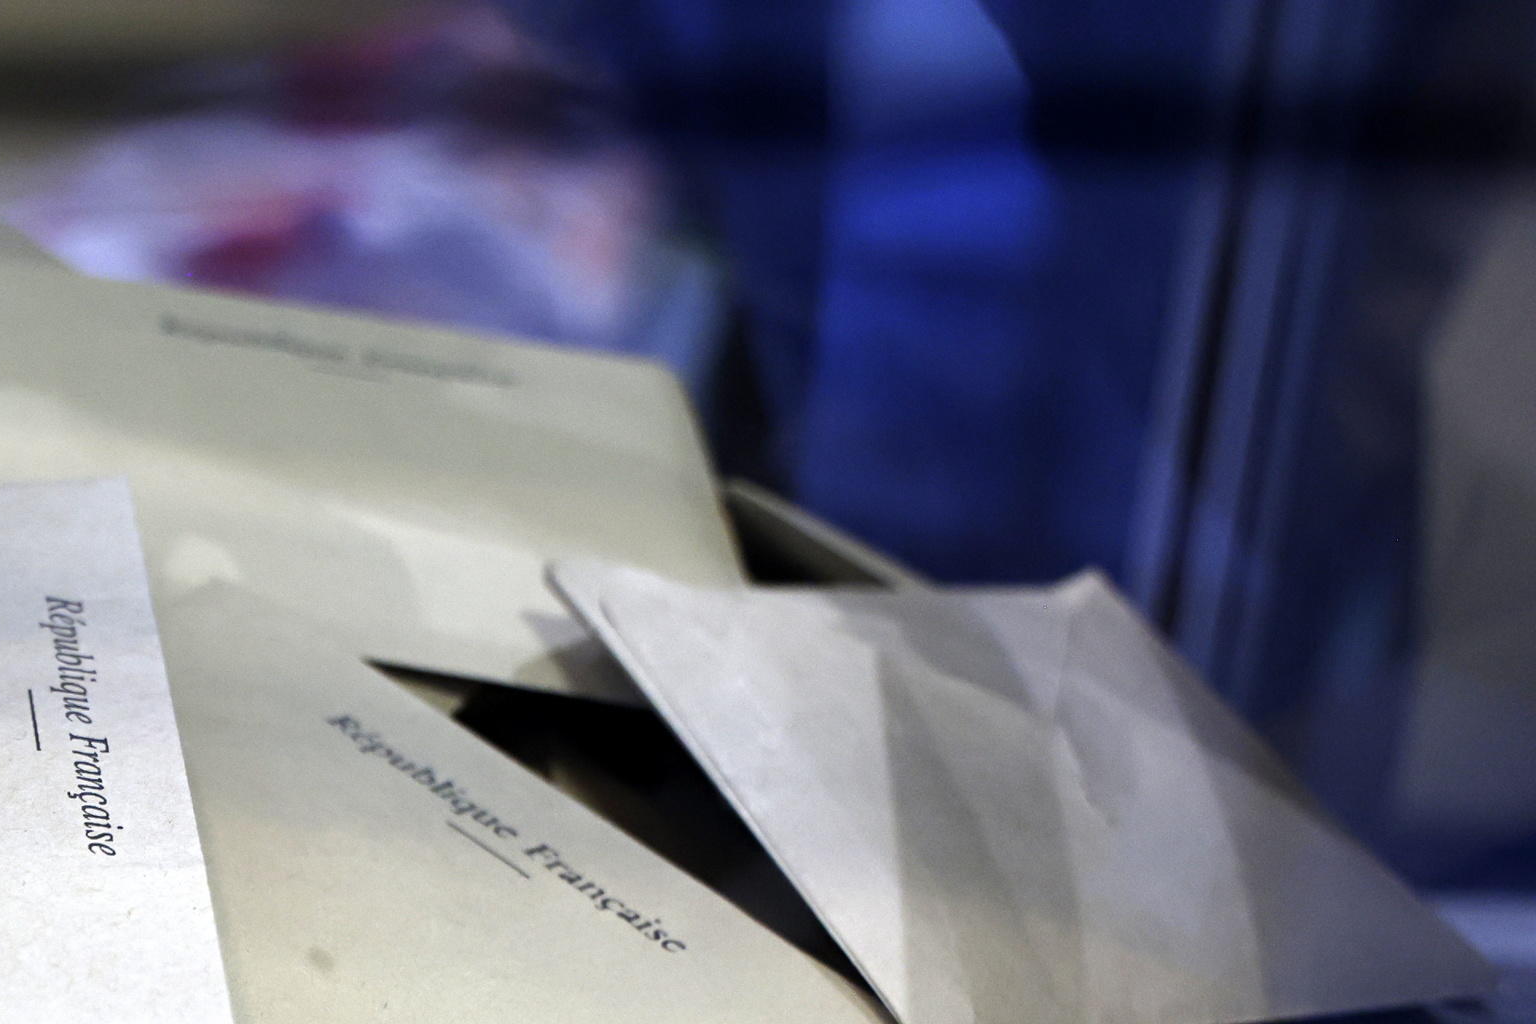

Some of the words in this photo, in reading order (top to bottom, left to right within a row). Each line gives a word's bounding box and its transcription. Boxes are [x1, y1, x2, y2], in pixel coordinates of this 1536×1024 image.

[38, 595, 97, 725] République
[67, 733, 123, 857] Française
[325, 714, 518, 840] République
[524, 842, 687, 954] Française
